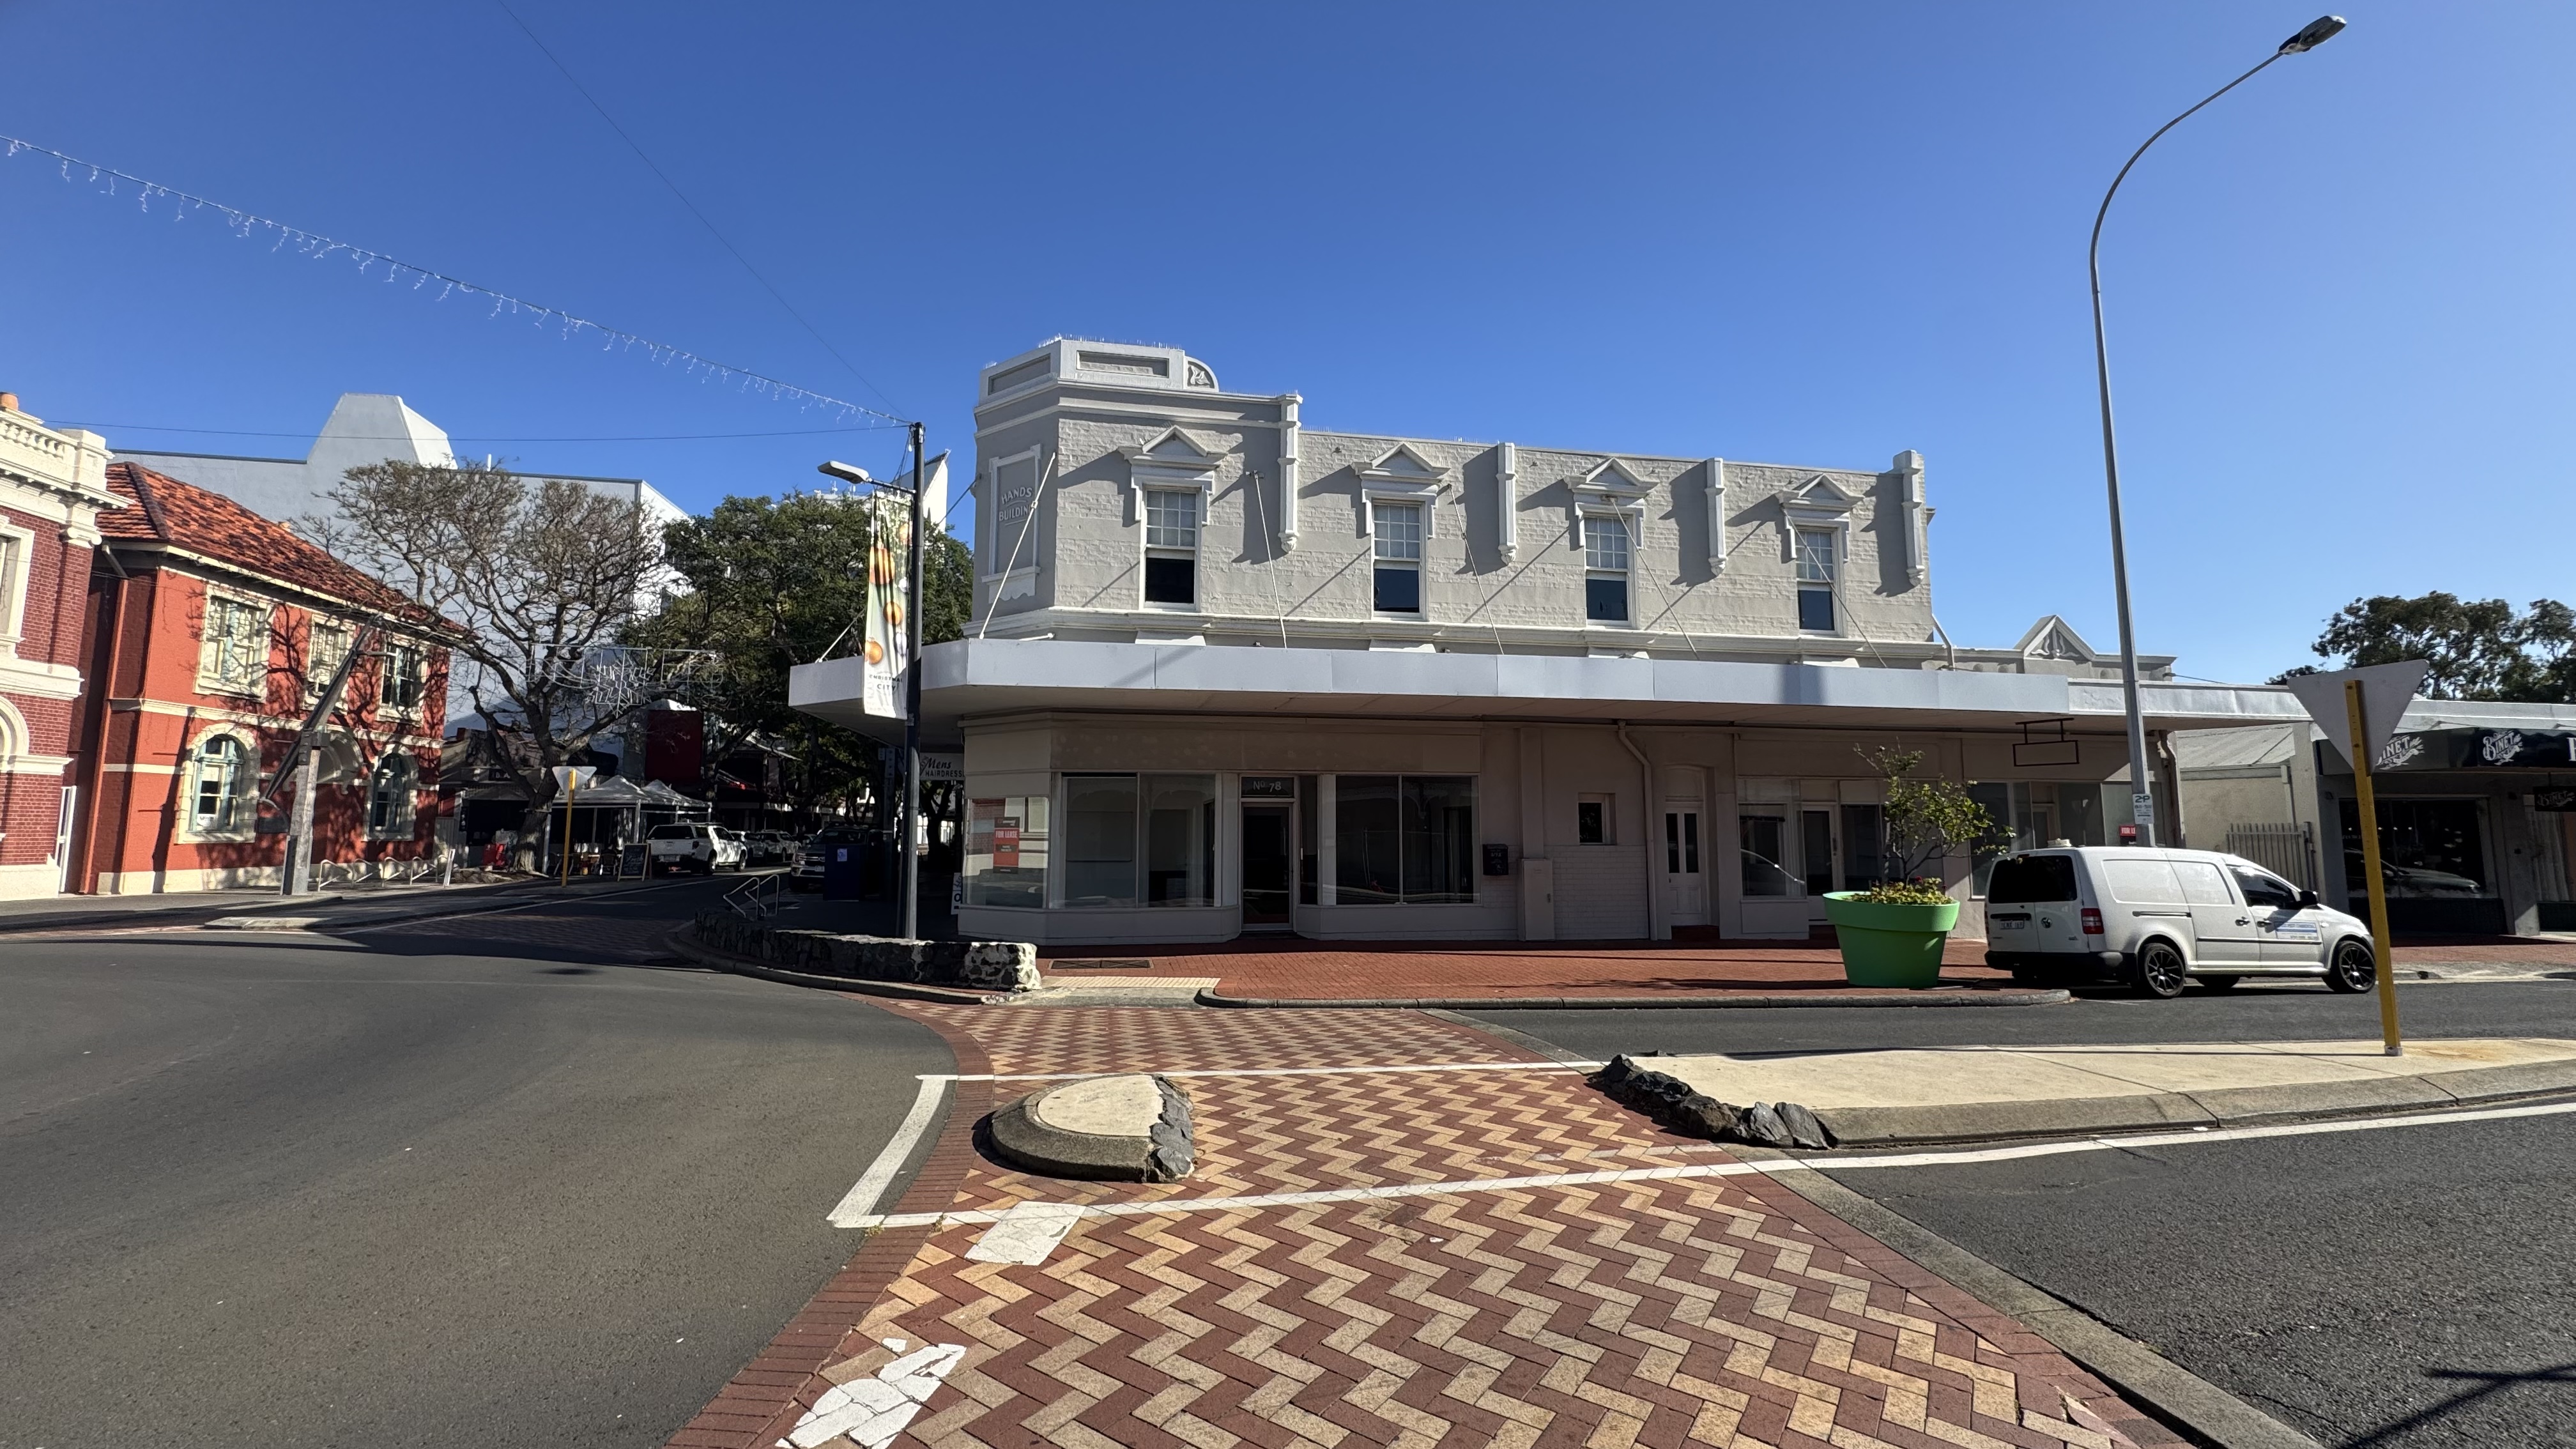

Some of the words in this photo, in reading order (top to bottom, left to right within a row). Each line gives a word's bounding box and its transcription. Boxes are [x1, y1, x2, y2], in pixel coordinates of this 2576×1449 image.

[1001, 487, 1032, 505] HANDS
[2483, 732, 2515, 761] BINET
[928, 757, 952, 769] Mens
[1269, 781, 1282, 792] 78
